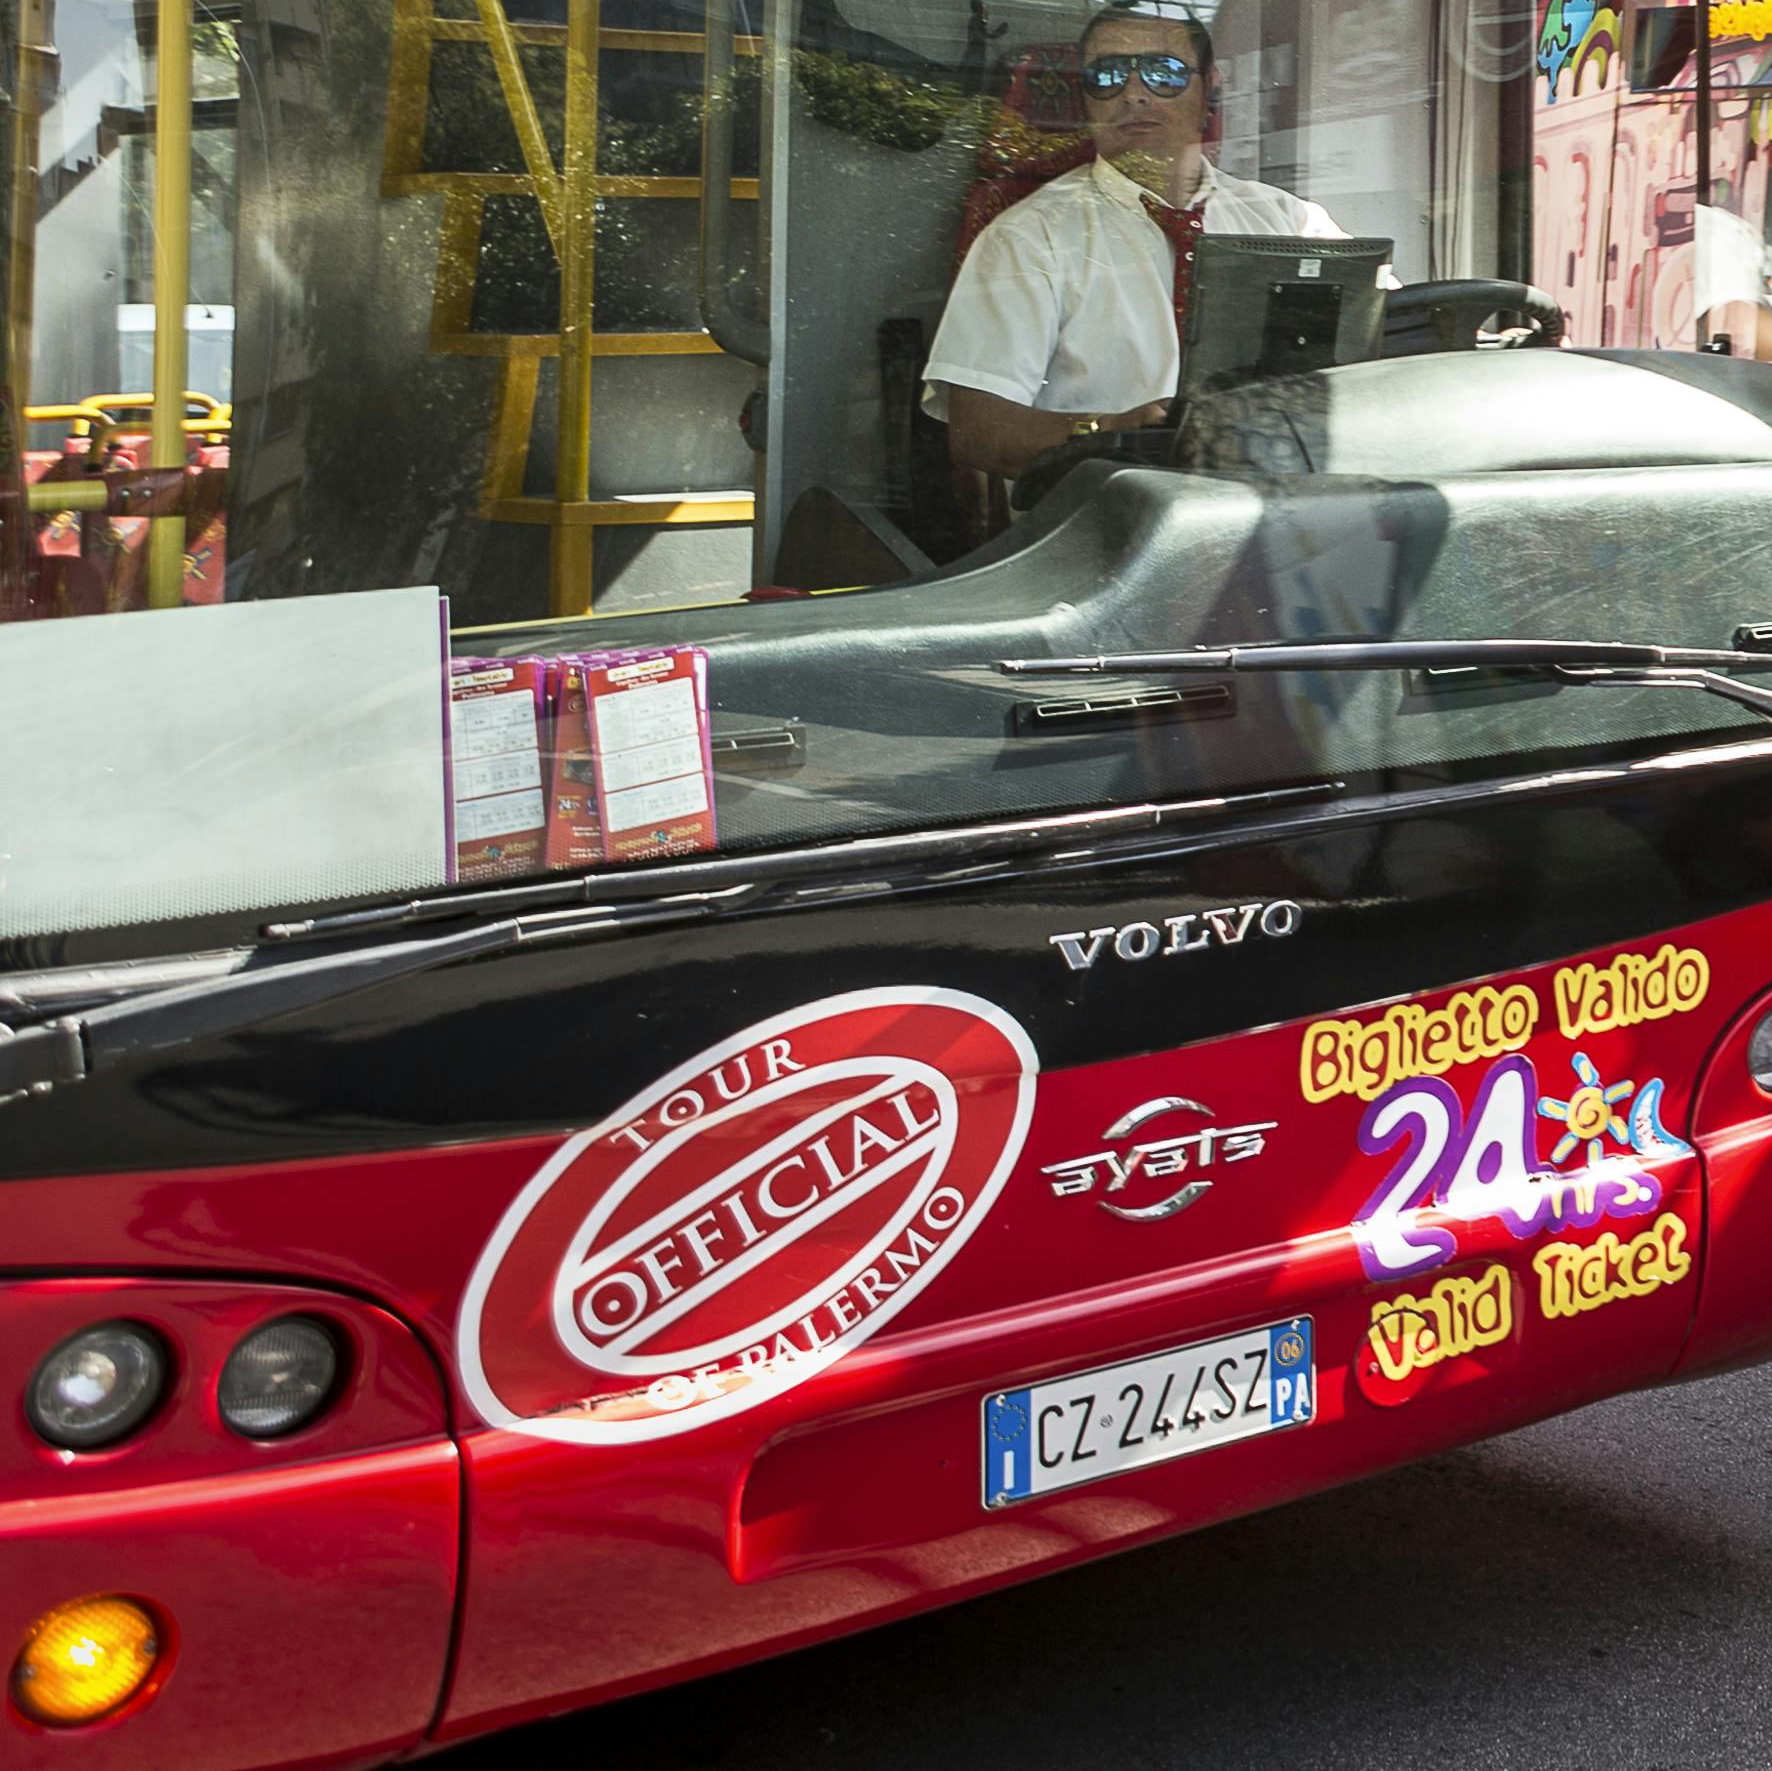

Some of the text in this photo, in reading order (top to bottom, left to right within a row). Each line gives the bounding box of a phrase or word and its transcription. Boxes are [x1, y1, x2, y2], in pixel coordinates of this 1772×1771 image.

[1049, 899, 1303, 970] VOLVO
[1300, 942, 1709, 1103] Biglietto Valido
[610, 1038, 807, 1154] TOUR
[1041, 1121, 1278, 1198] ayats
[579, 1088, 940, 1336] OFFICIAL
[1352, 1053, 1550, 1281] 24
[646, 1184, 964, 1411] OF PALERMO
[1367, 1212, 1692, 1381] Valid Ticket
[1036, 1346, 1268, 1468] CZ 244SZ
[1274, 1370, 1310, 1418] PA
